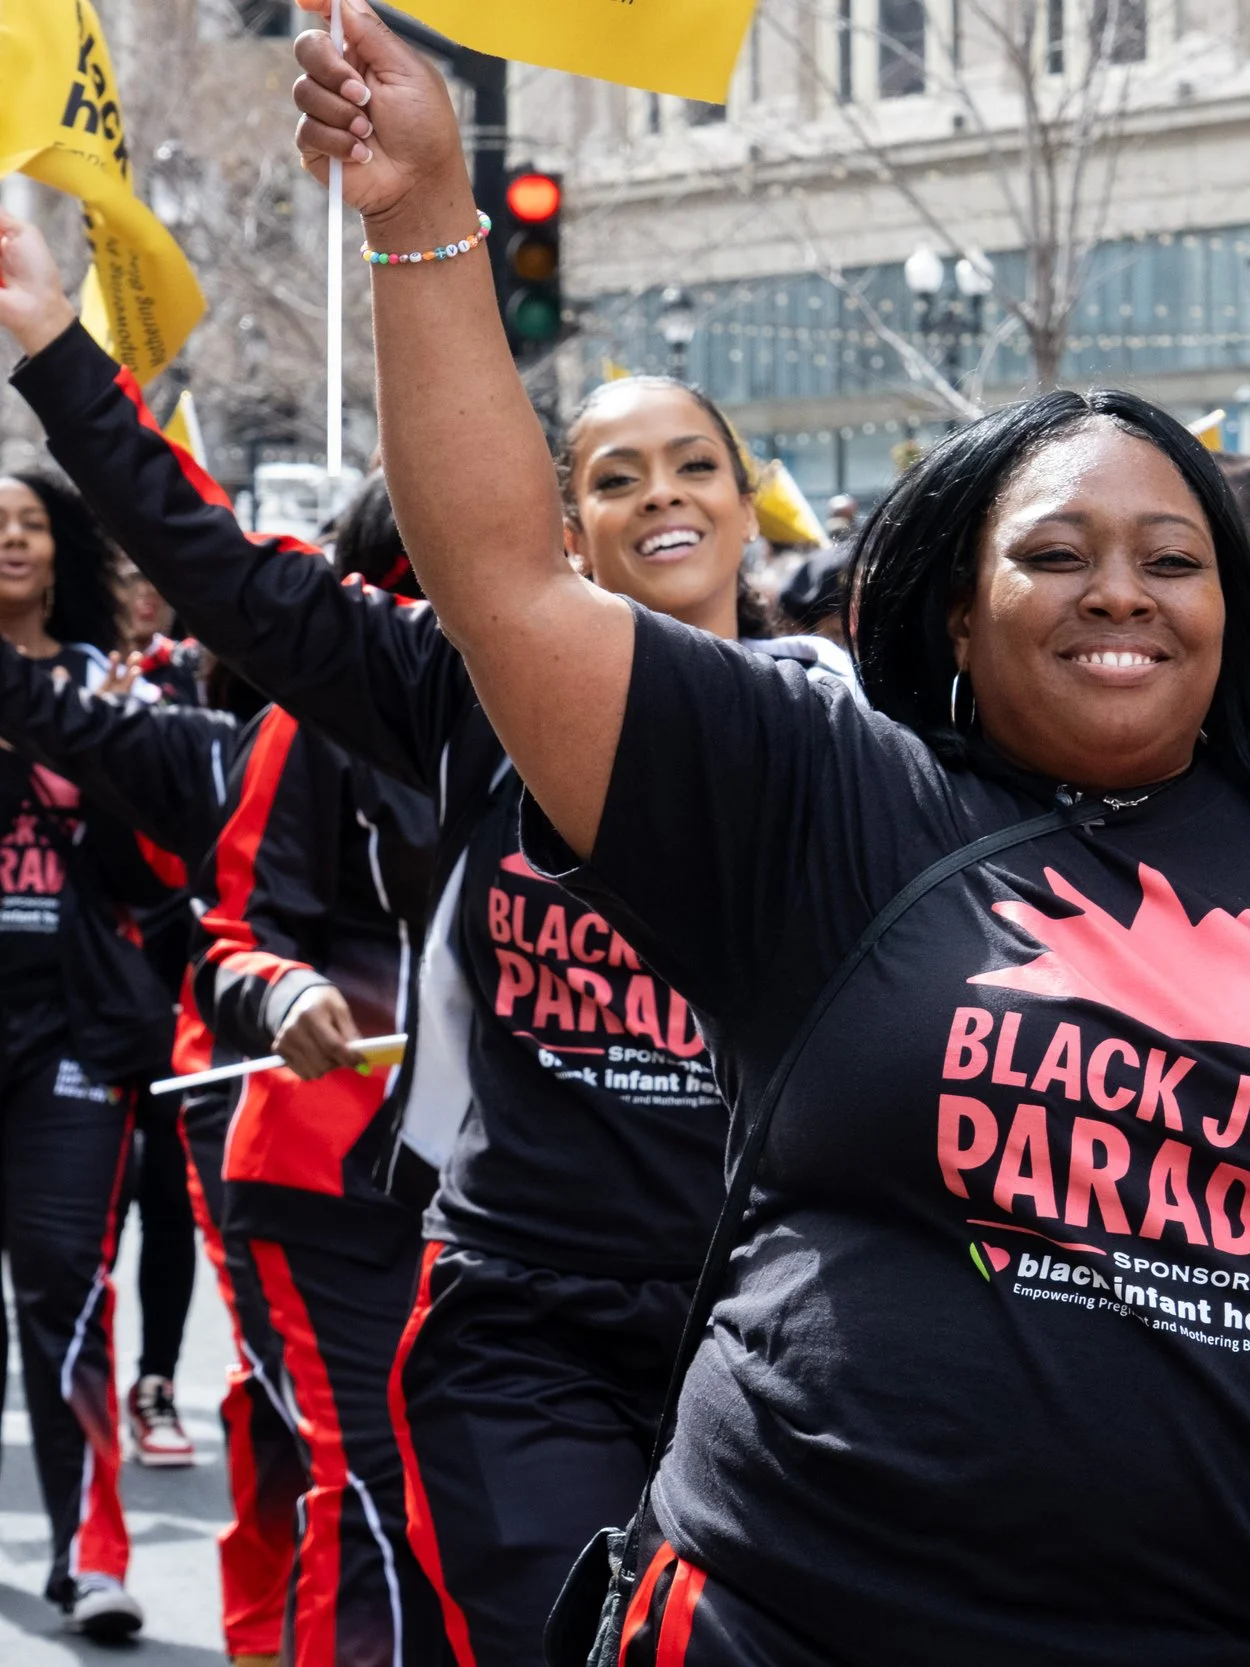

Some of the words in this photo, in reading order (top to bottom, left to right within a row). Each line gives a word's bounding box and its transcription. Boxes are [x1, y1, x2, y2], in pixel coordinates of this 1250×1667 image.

[495, 948, 705, 1058] PARAD
[604, 1067, 680, 1092] infant
[941, 1006, 1197, 1131] BLACK
[1013, 1283, 1095, 1310] Empowering
[1152, 1318, 1177, 1333] and
[1180, 1325, 1240, 1352] Mothering
[1017, 1253, 1111, 1291] black
[1114, 1276, 1212, 1324] infant
